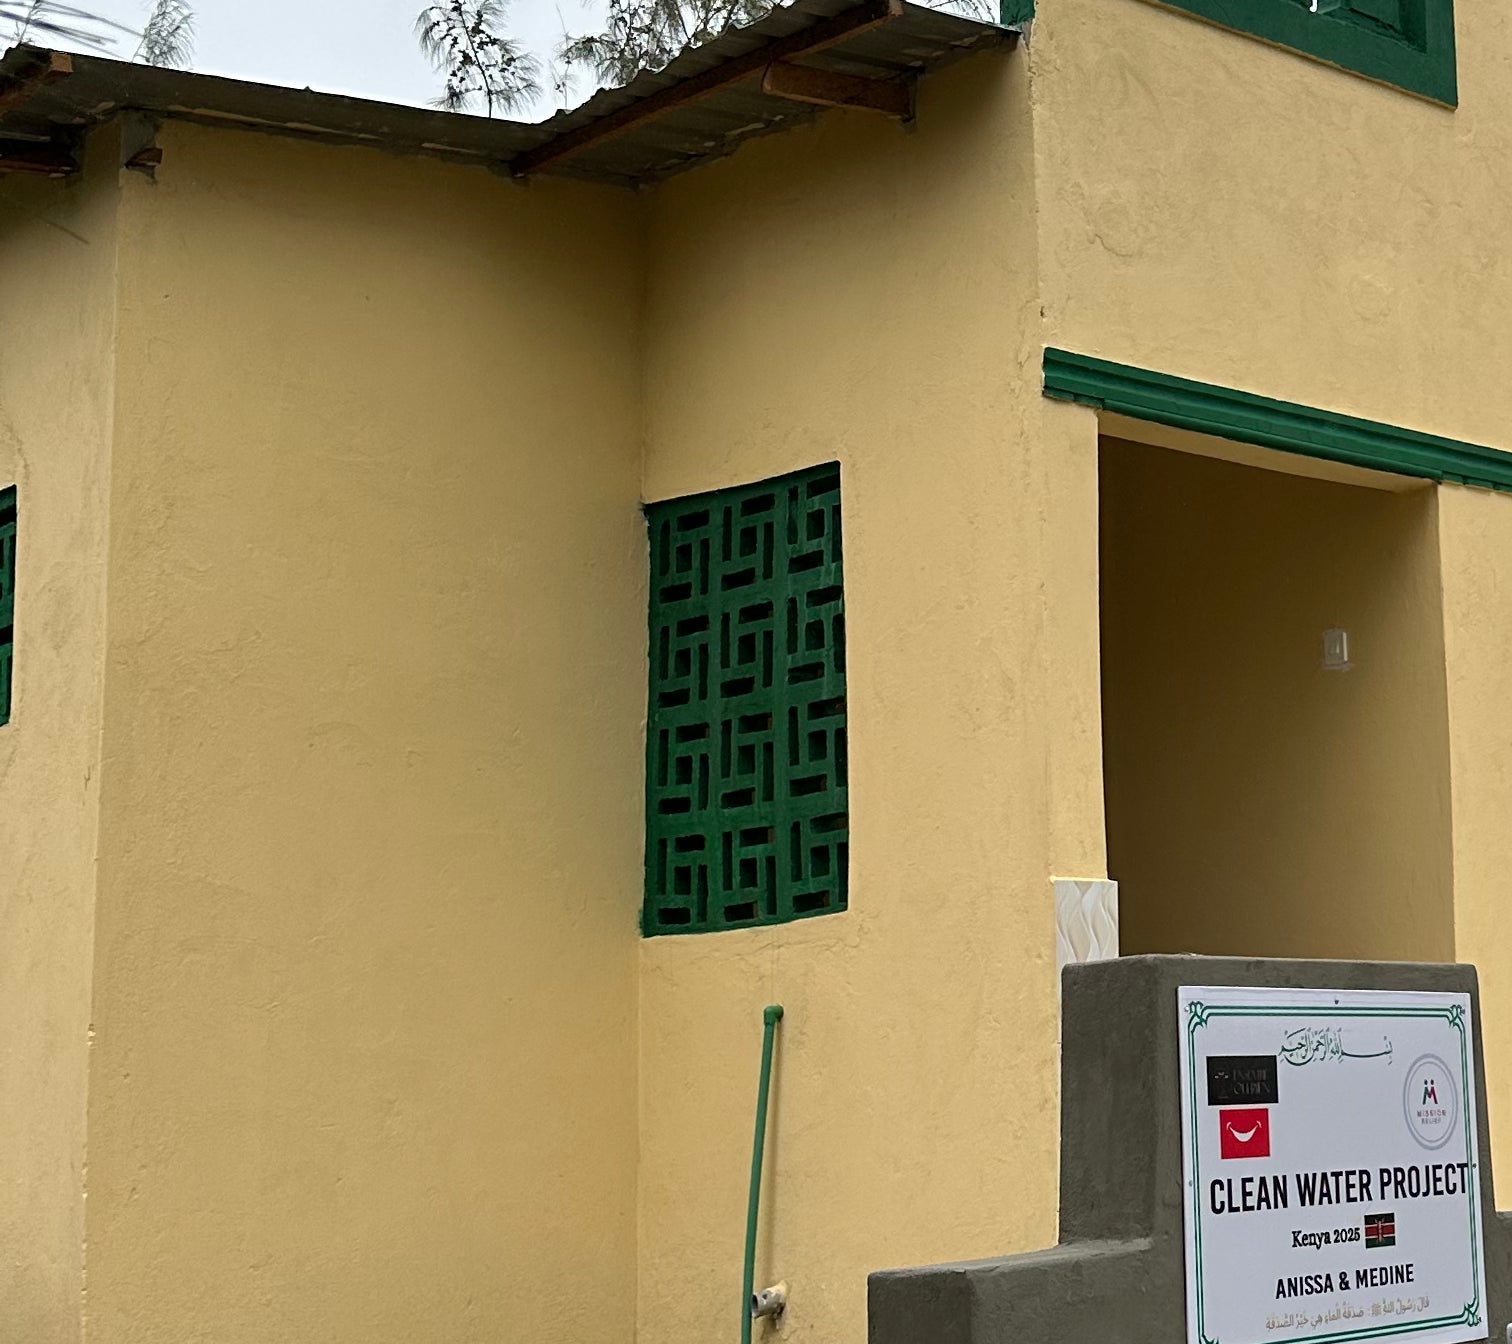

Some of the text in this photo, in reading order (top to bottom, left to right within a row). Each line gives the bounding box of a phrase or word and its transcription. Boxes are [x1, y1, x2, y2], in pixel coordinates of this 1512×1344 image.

[1210, 1163, 1468, 1215] CLEAN WATER PROJECT
[1292, 1227, 1361, 1250] Kenya 2025
[1275, 1263, 1415, 1300] ANISSA & MEDINE
